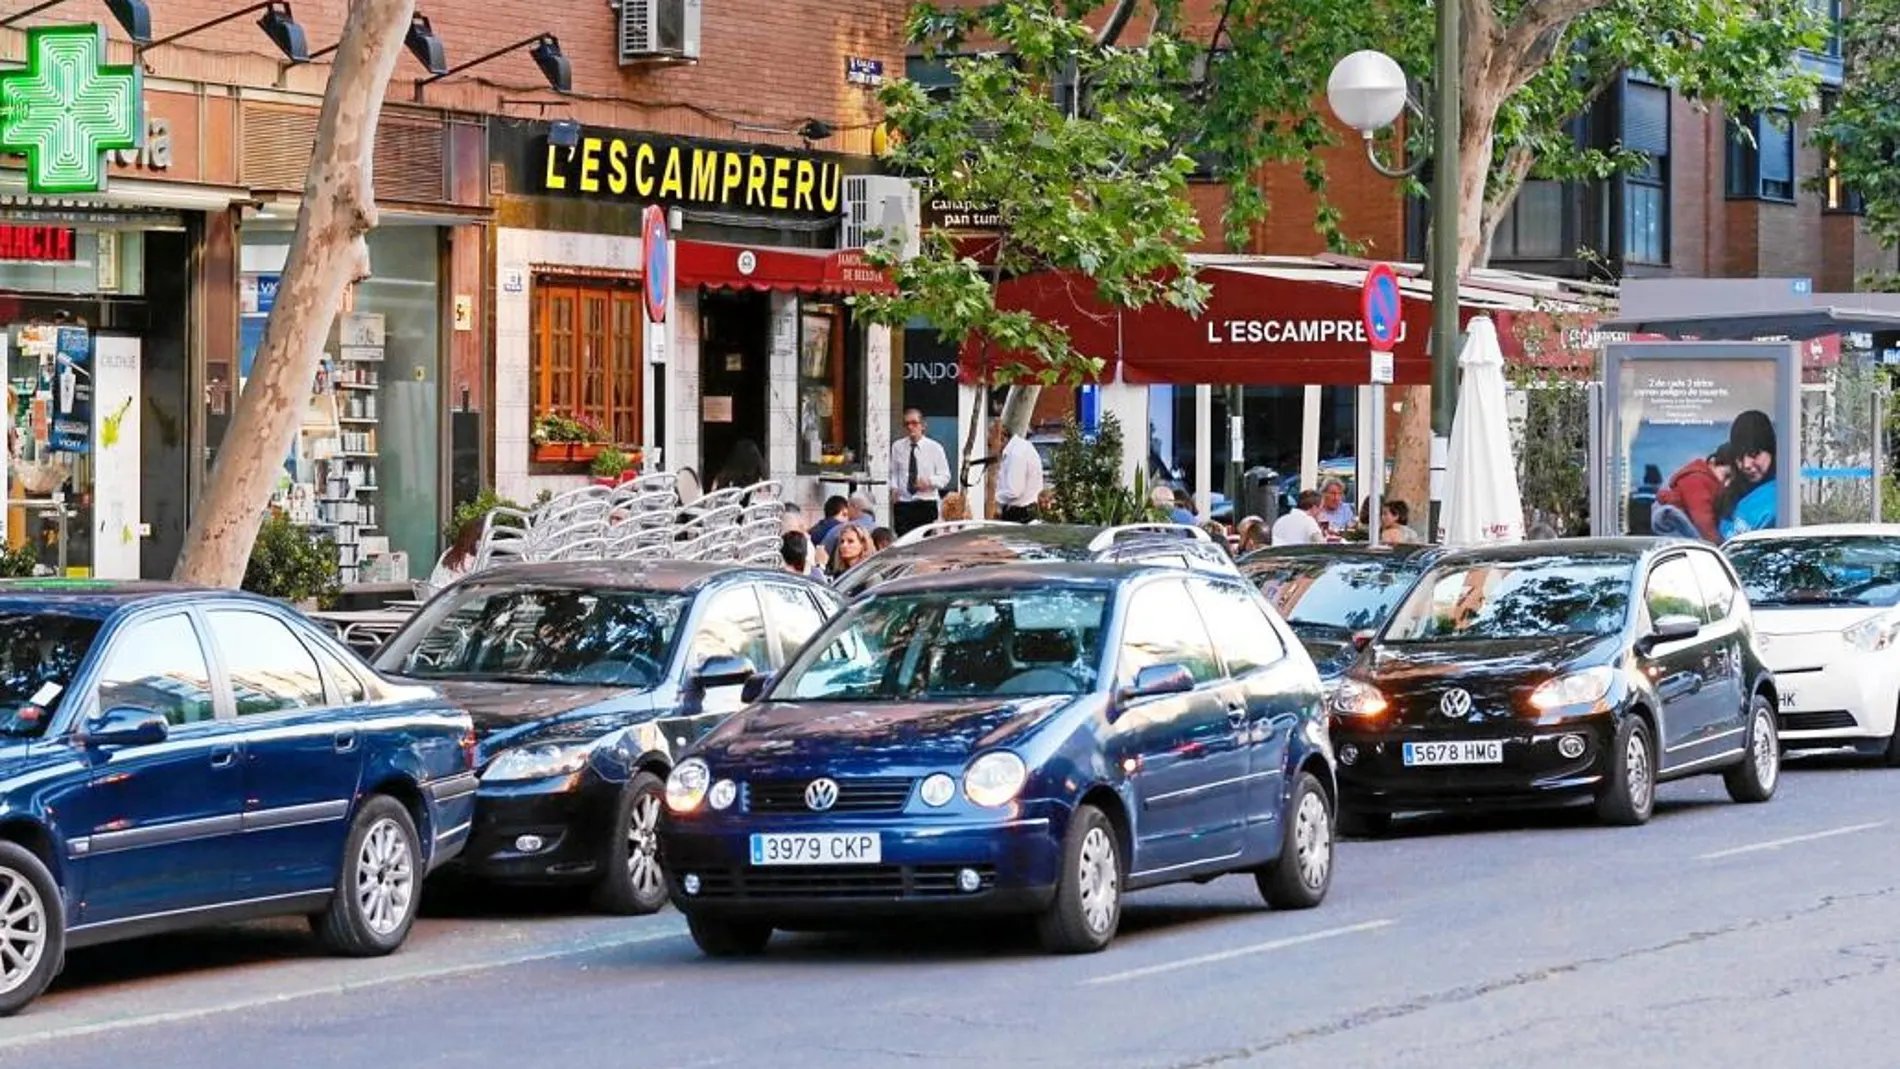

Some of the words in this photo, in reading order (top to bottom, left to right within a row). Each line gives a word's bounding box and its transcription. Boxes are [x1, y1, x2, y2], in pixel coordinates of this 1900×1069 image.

[545, 137, 840, 213] L'ESCAMPRERU
[944, 213, 970, 227] pan
[1415, 744, 1459, 762] 5678
[1464, 743, 1498, 761] HMG
[767, 837, 821, 860] 3979
[830, 835, 873, 859] CKP
